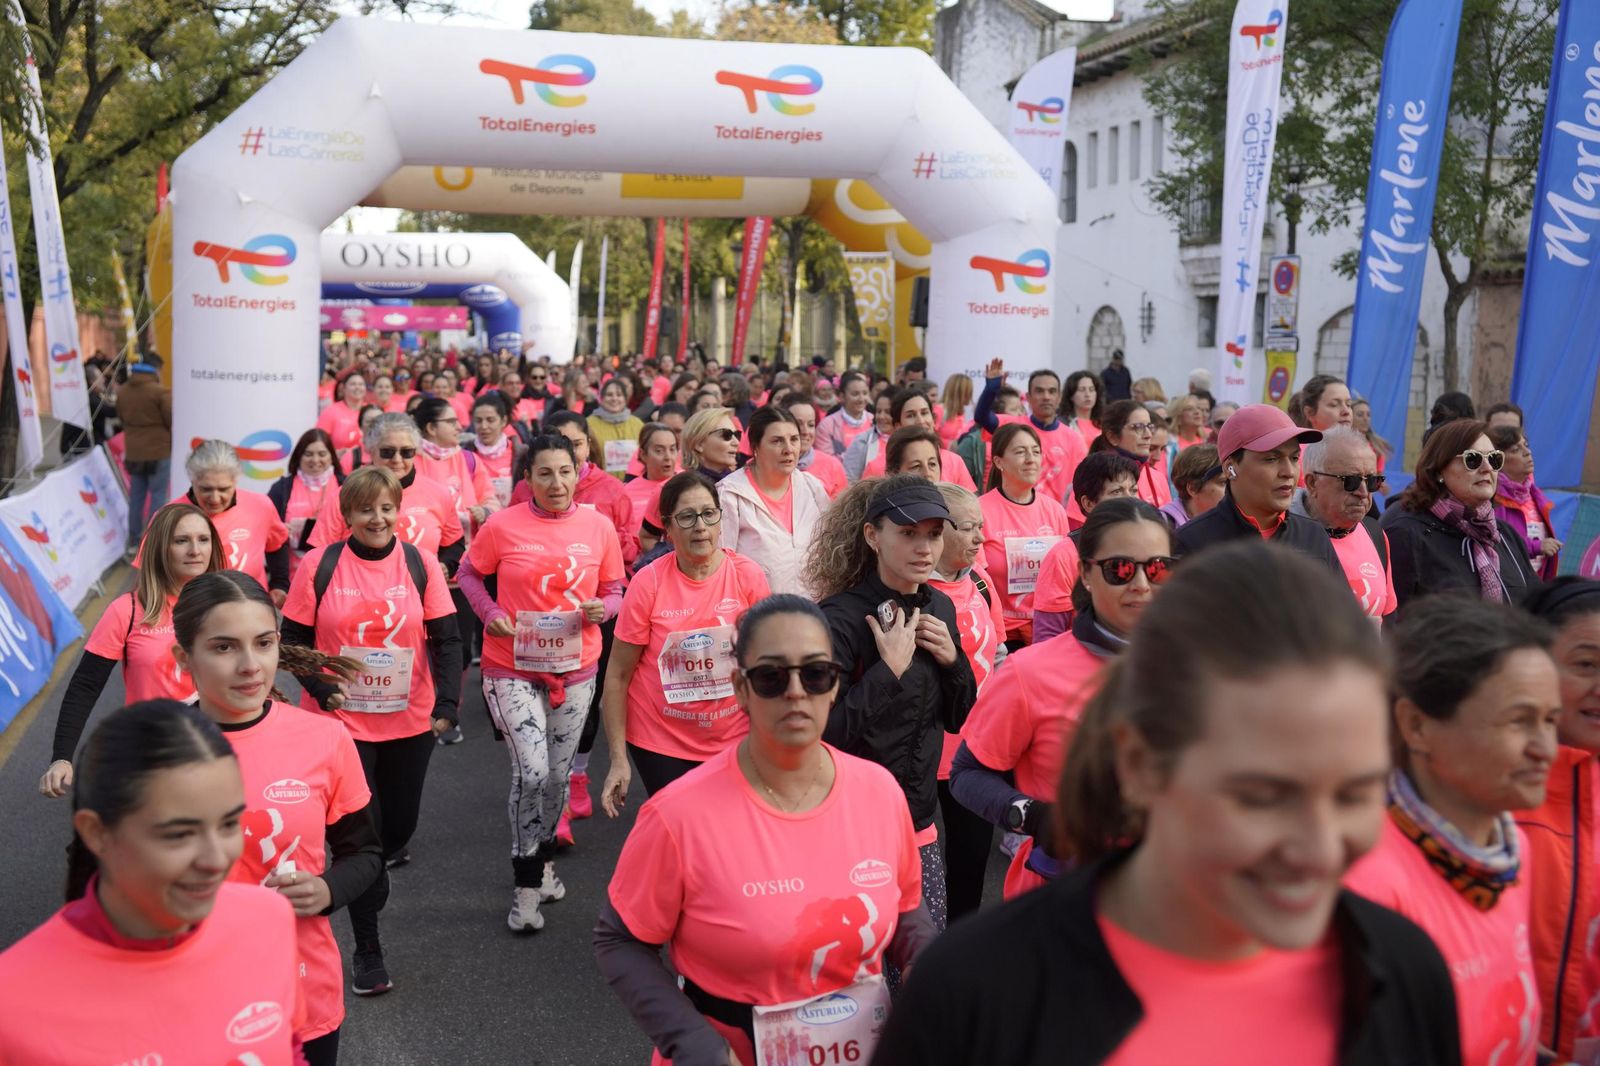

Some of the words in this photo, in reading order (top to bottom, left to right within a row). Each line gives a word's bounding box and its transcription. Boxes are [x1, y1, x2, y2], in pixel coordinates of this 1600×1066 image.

[479, 115, 597, 138] TotalEnergies
[714, 125, 824, 145] TotalEnergies
[509, 182, 526, 193] de
[528, 183, 585, 196] Deportes
[1367, 99, 1429, 294] Marlene
[340, 241, 471, 269] OYSHO
[192, 293, 297, 314] TotalEnergies
[190, 368, 295, 384] totalenergies.es
[1027, 559, 1041, 570] 01
[660, 607, 695, 618] OYSHO
[538, 638, 564, 648] 016
[683, 641, 712, 649] ASTURIANA
[685, 658, 714, 672] 016
[364, 675, 392, 687] 016
[742, 877, 805, 897] OYSHO
[799, 1004, 855, 1020] ASTURIANA
[808, 1039, 861, 1066] 016
